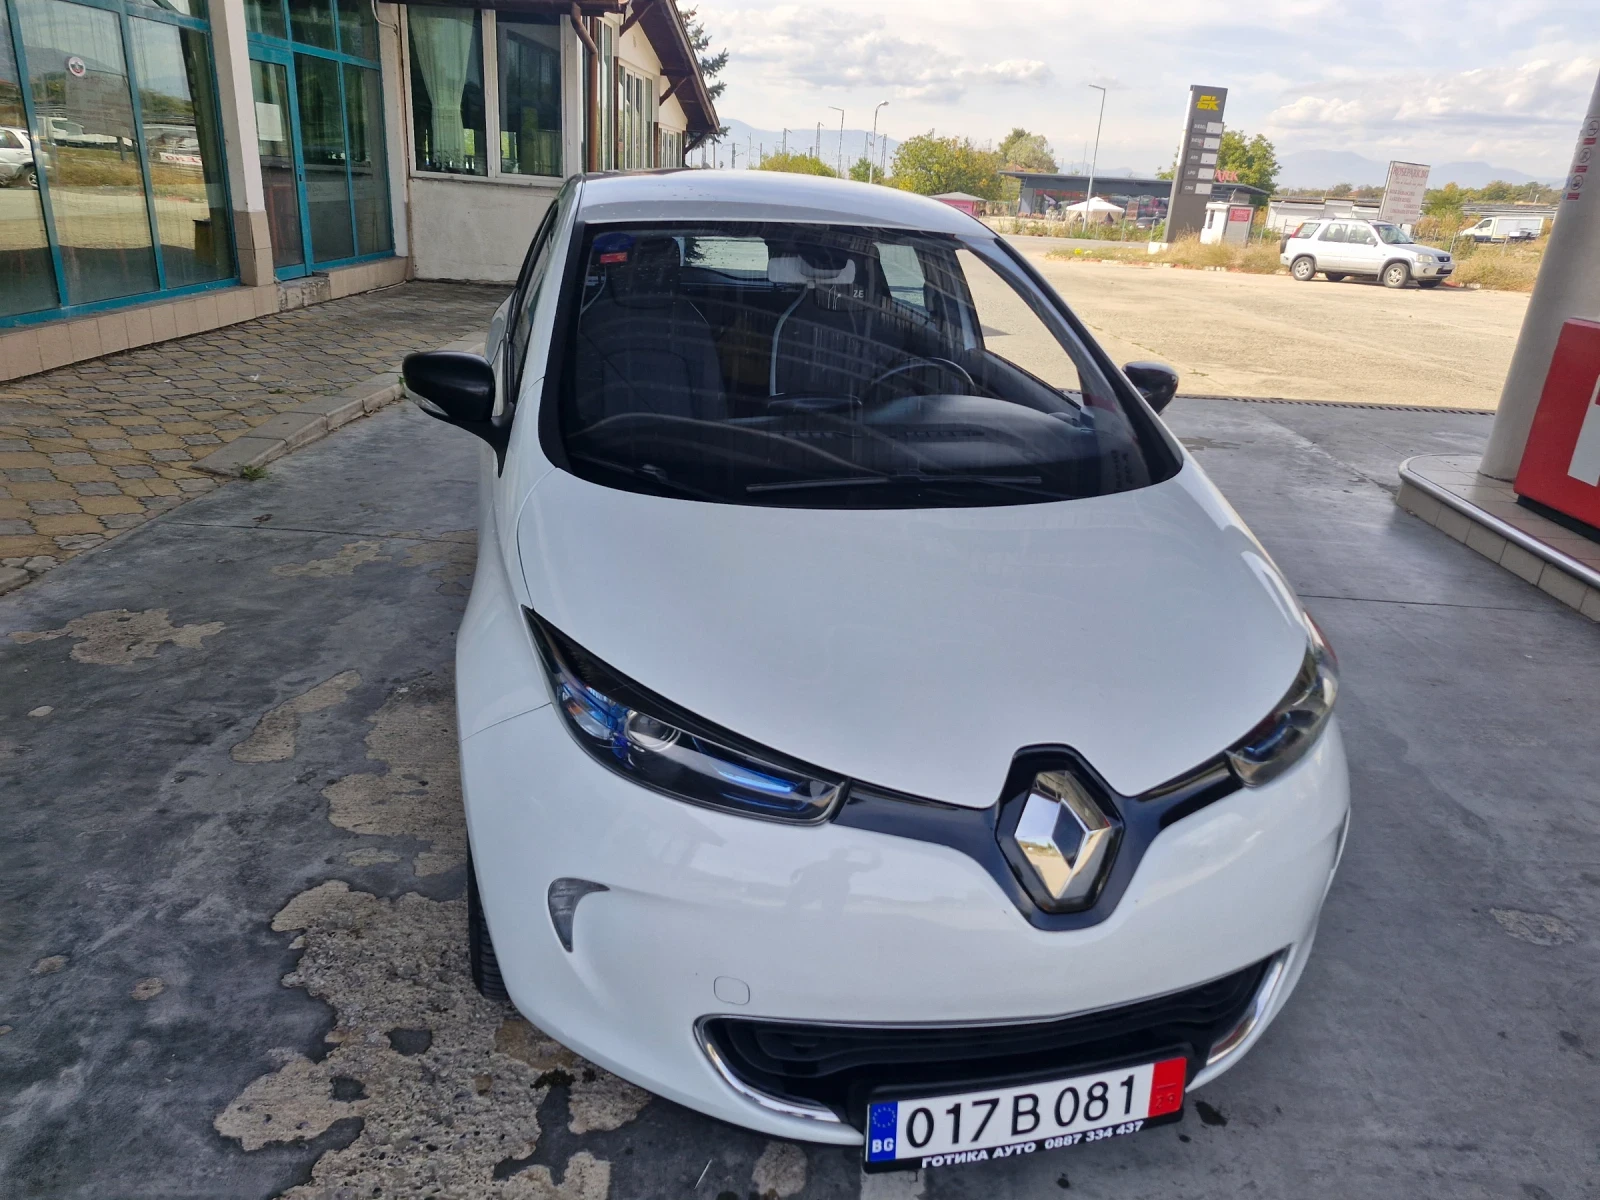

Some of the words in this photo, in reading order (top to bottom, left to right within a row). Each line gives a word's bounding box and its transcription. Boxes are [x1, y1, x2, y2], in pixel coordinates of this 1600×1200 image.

[905, 1097, 1001, 1149] 017
[1054, 1074, 1136, 1127] 081
[872, 1137, 894, 1153] BG
[921, 1148, 989, 1169] ГОТИКА
[993, 1141, 1037, 1159] АУТО
[1045, 1133, 1082, 1149] 0887
[1085, 1127, 1113, 1144] 334
[1116, 1120, 1145, 1136] 437
